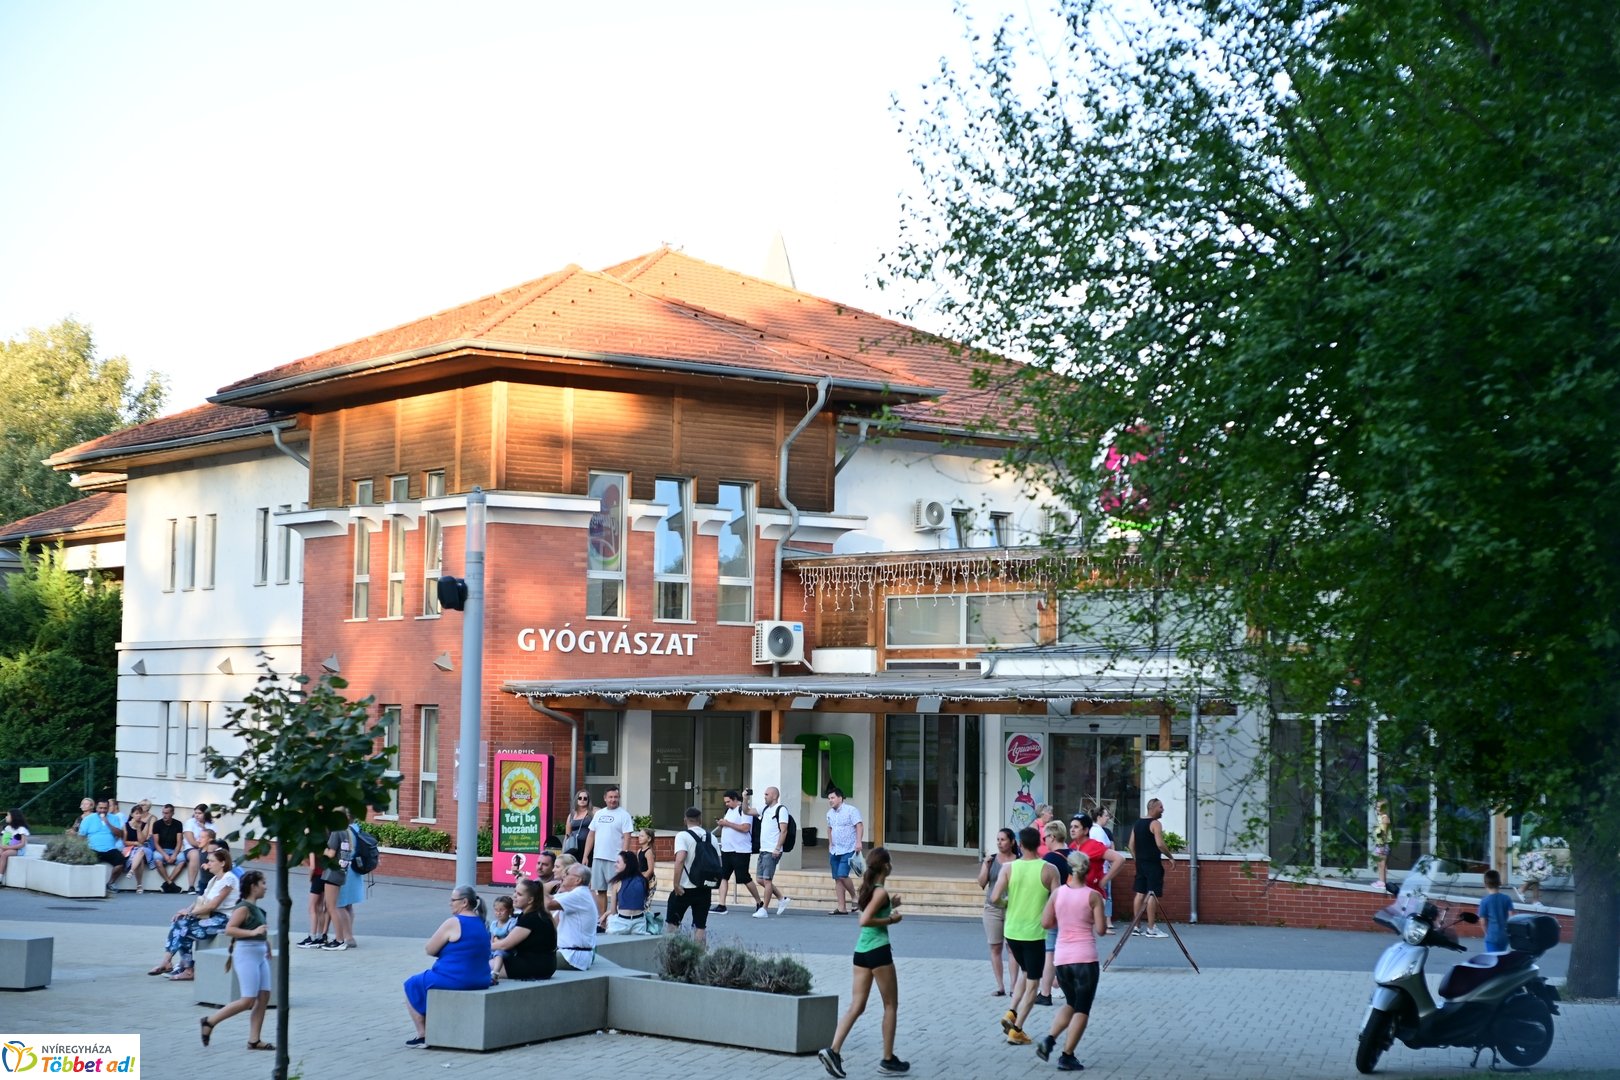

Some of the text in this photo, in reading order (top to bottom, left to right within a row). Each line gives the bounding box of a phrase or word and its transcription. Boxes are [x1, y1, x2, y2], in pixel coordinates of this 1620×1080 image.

[517, 623, 698, 656] GYÓGYÁSZAT
[505, 813, 537, 825] Térj be
[501, 824, 538, 834] hozzánk!
